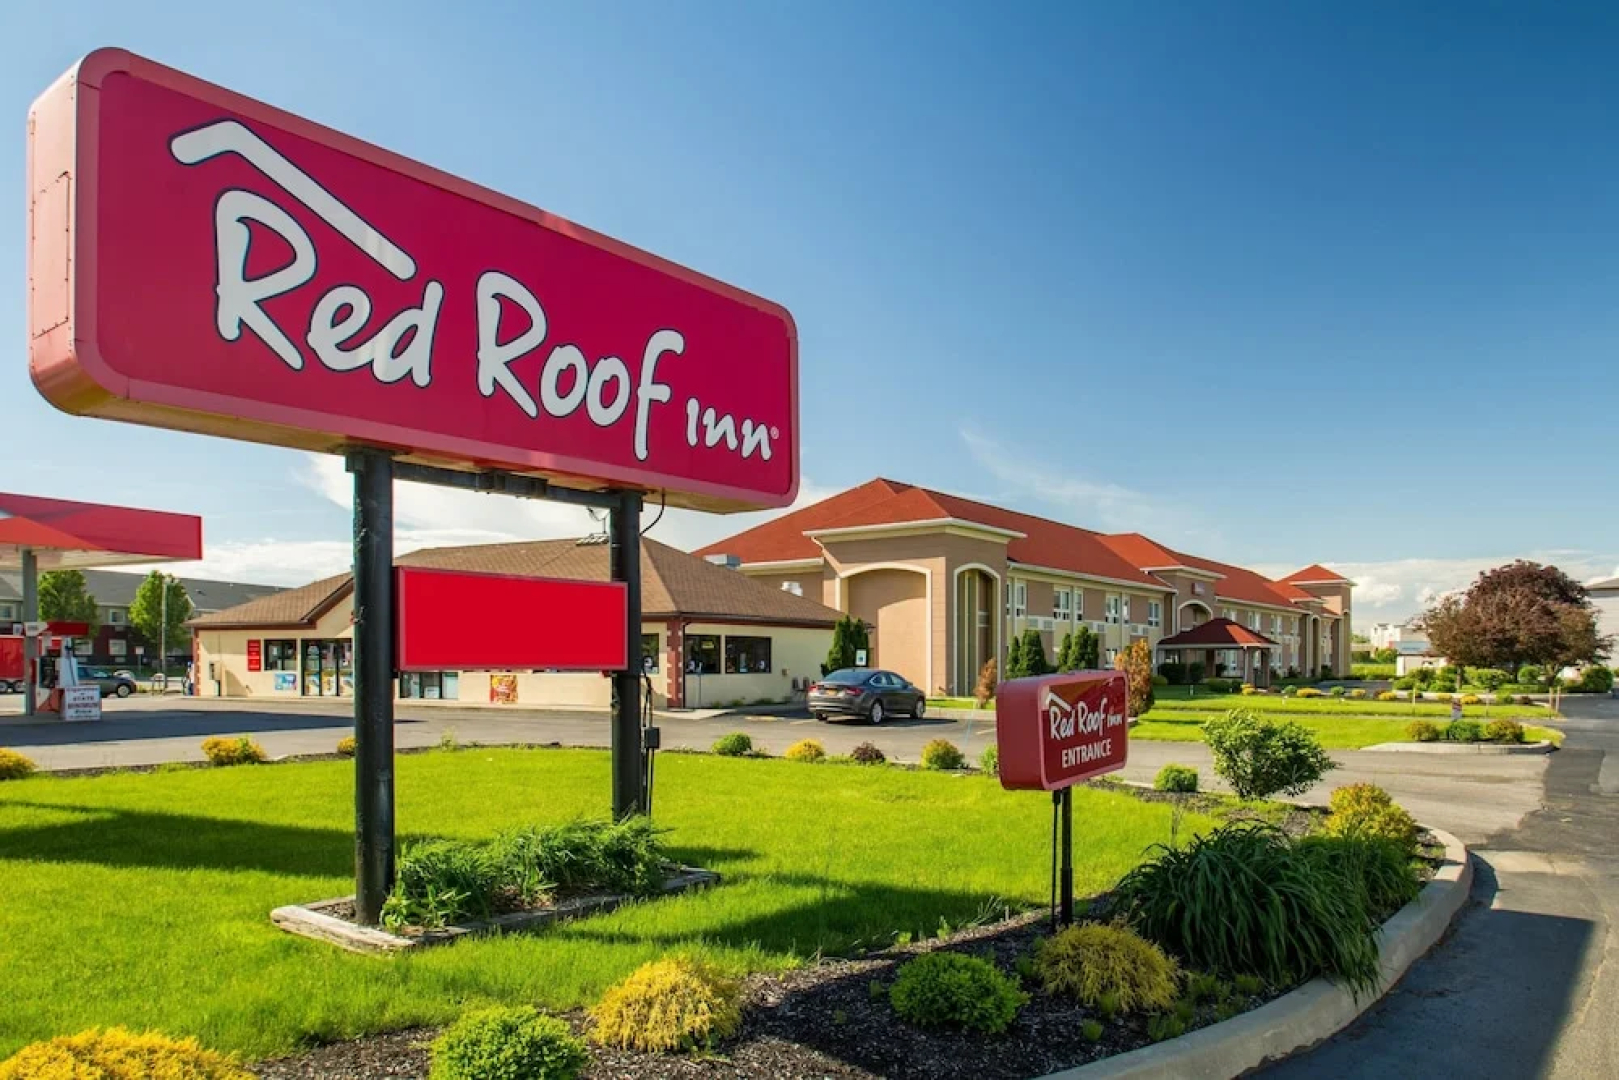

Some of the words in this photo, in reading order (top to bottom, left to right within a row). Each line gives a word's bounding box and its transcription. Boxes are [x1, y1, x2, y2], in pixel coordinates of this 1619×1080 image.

[214, 188, 444, 388] Red
[476, 270, 686, 461] Roof
[1049, 705, 1076, 740] Red
[1077, 697, 1108, 736] Roof
[1061, 738, 1112, 768] ENTRANCE
